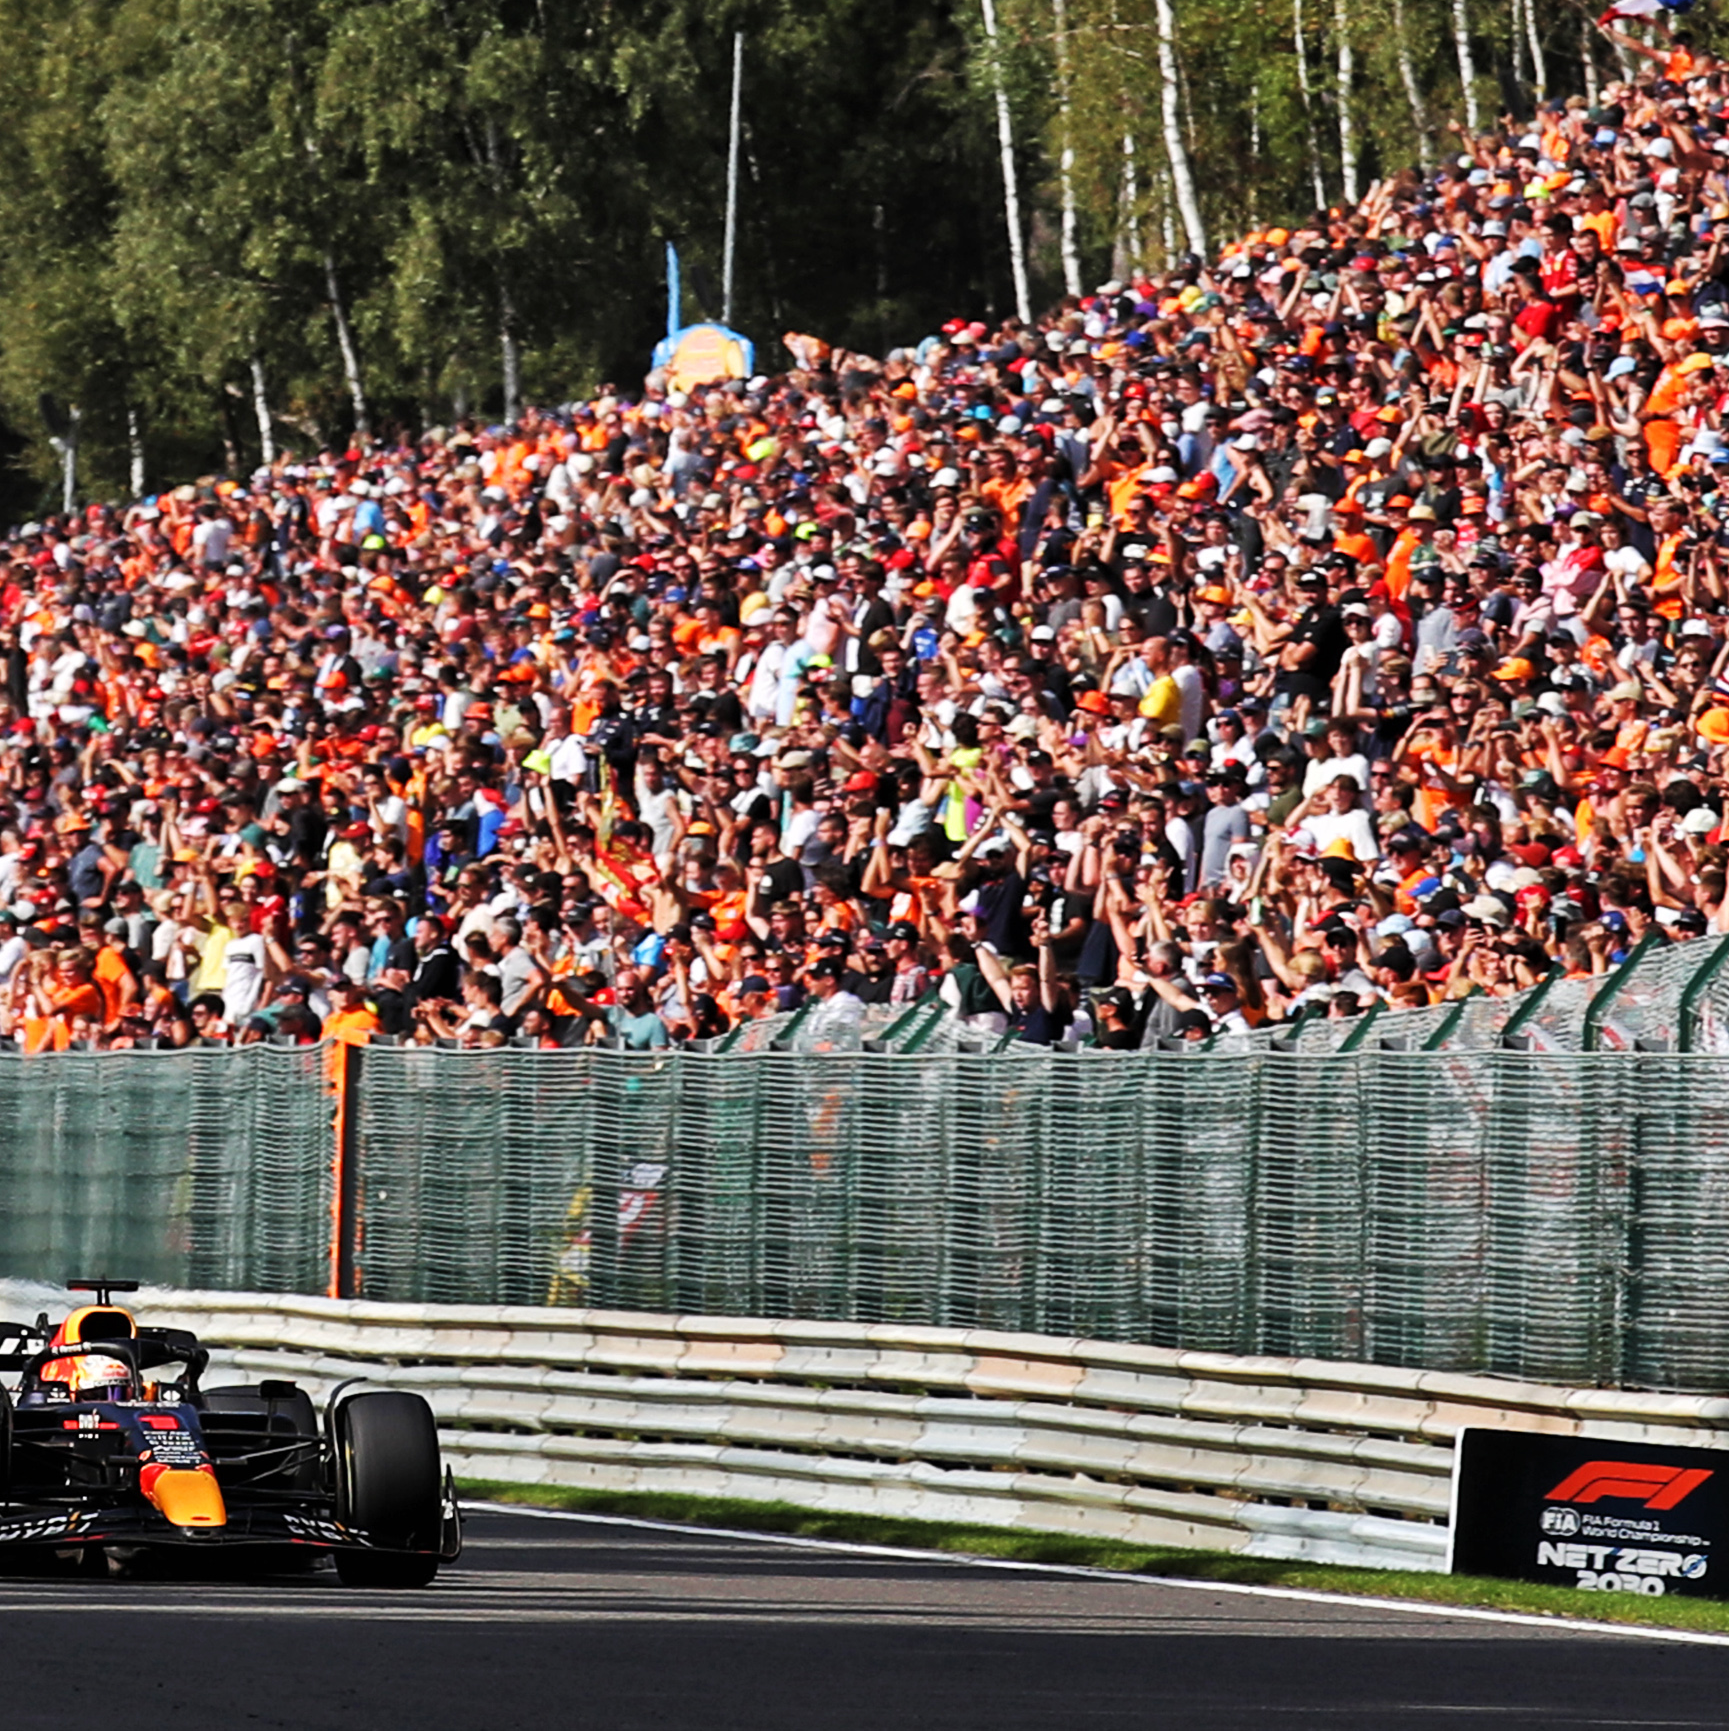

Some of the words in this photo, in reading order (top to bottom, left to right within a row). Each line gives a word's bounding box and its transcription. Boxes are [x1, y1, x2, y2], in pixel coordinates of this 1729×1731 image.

[1543, 1461, 1715, 1511] F1
[1542, 1511, 1577, 1532] FIA
[1582, 1514, 1603, 1526] FIA
[1604, 1516, 1652, 1530] Formula
[1653, 1520, 1660, 1531] 1
[1582, 1526, 1618, 1538] World
[1618, 1528, 1702, 1546] Championship
[1537, 1541, 1616, 1570] NET
[1615, 1548, 1709, 1579] ZERO
[1576, 1570, 1666, 1597] 2030
